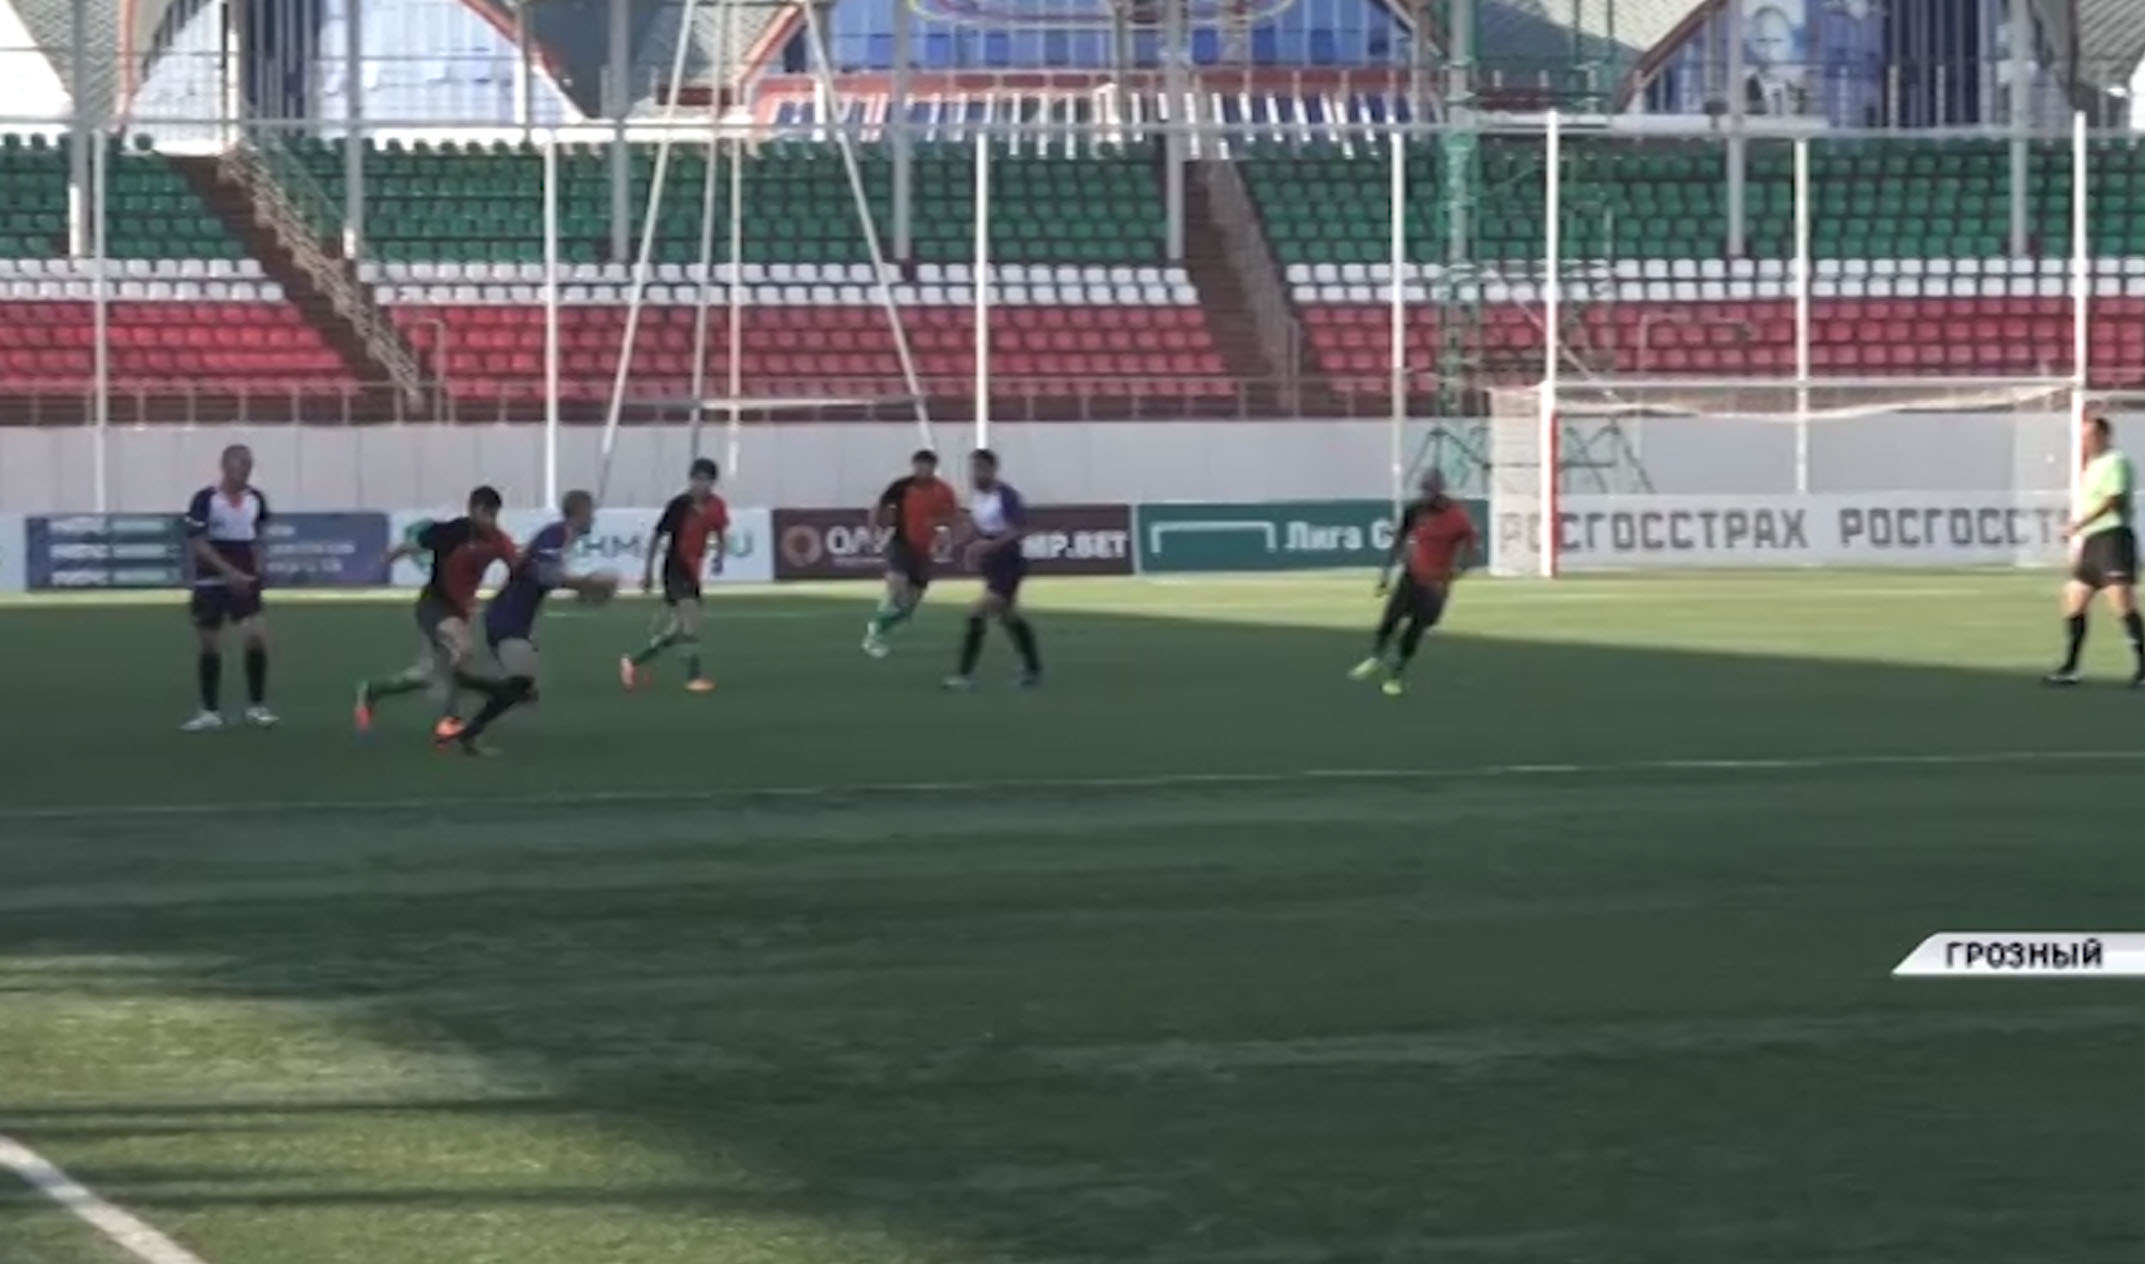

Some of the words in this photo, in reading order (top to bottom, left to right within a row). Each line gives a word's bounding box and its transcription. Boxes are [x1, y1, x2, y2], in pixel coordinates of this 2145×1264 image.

[1284, 520, 1362, 549] Лига
[1370, 518, 1395, 550] С
[1500, 509, 1809, 552] РОСГОССТРАХ
